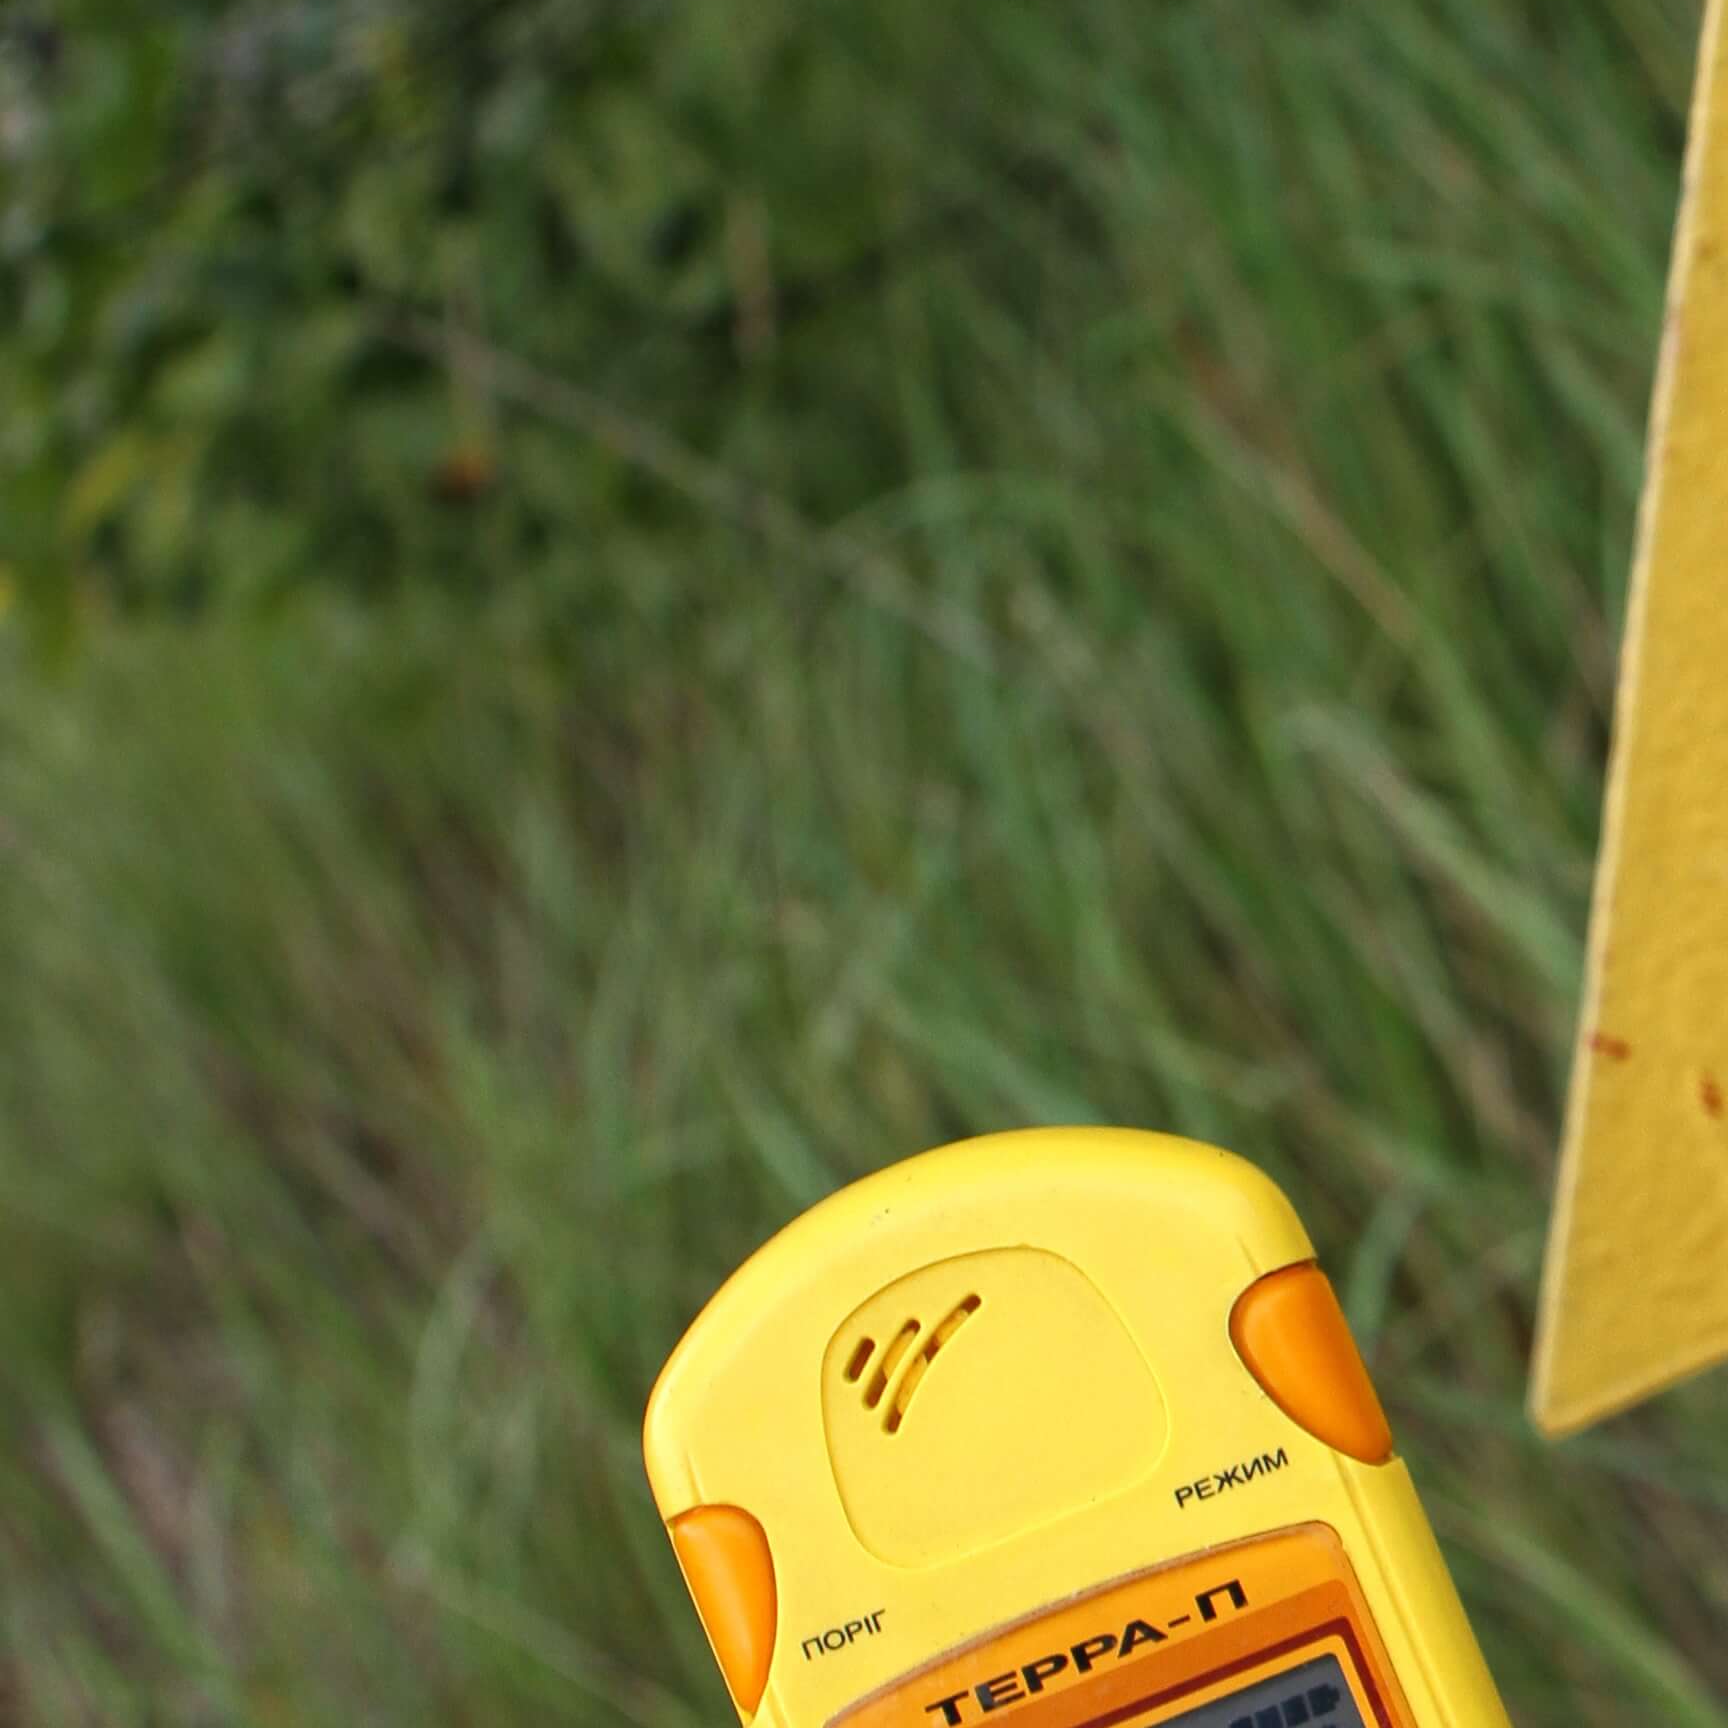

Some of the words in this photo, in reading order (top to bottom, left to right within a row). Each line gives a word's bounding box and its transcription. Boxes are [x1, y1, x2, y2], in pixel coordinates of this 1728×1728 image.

[1175, 1448, 1289, 1508] РЕЖИМ
[801, 1610, 886, 1661] ПОРІГ
[926, 1580, 1249, 1727] ТЕРРА-П
